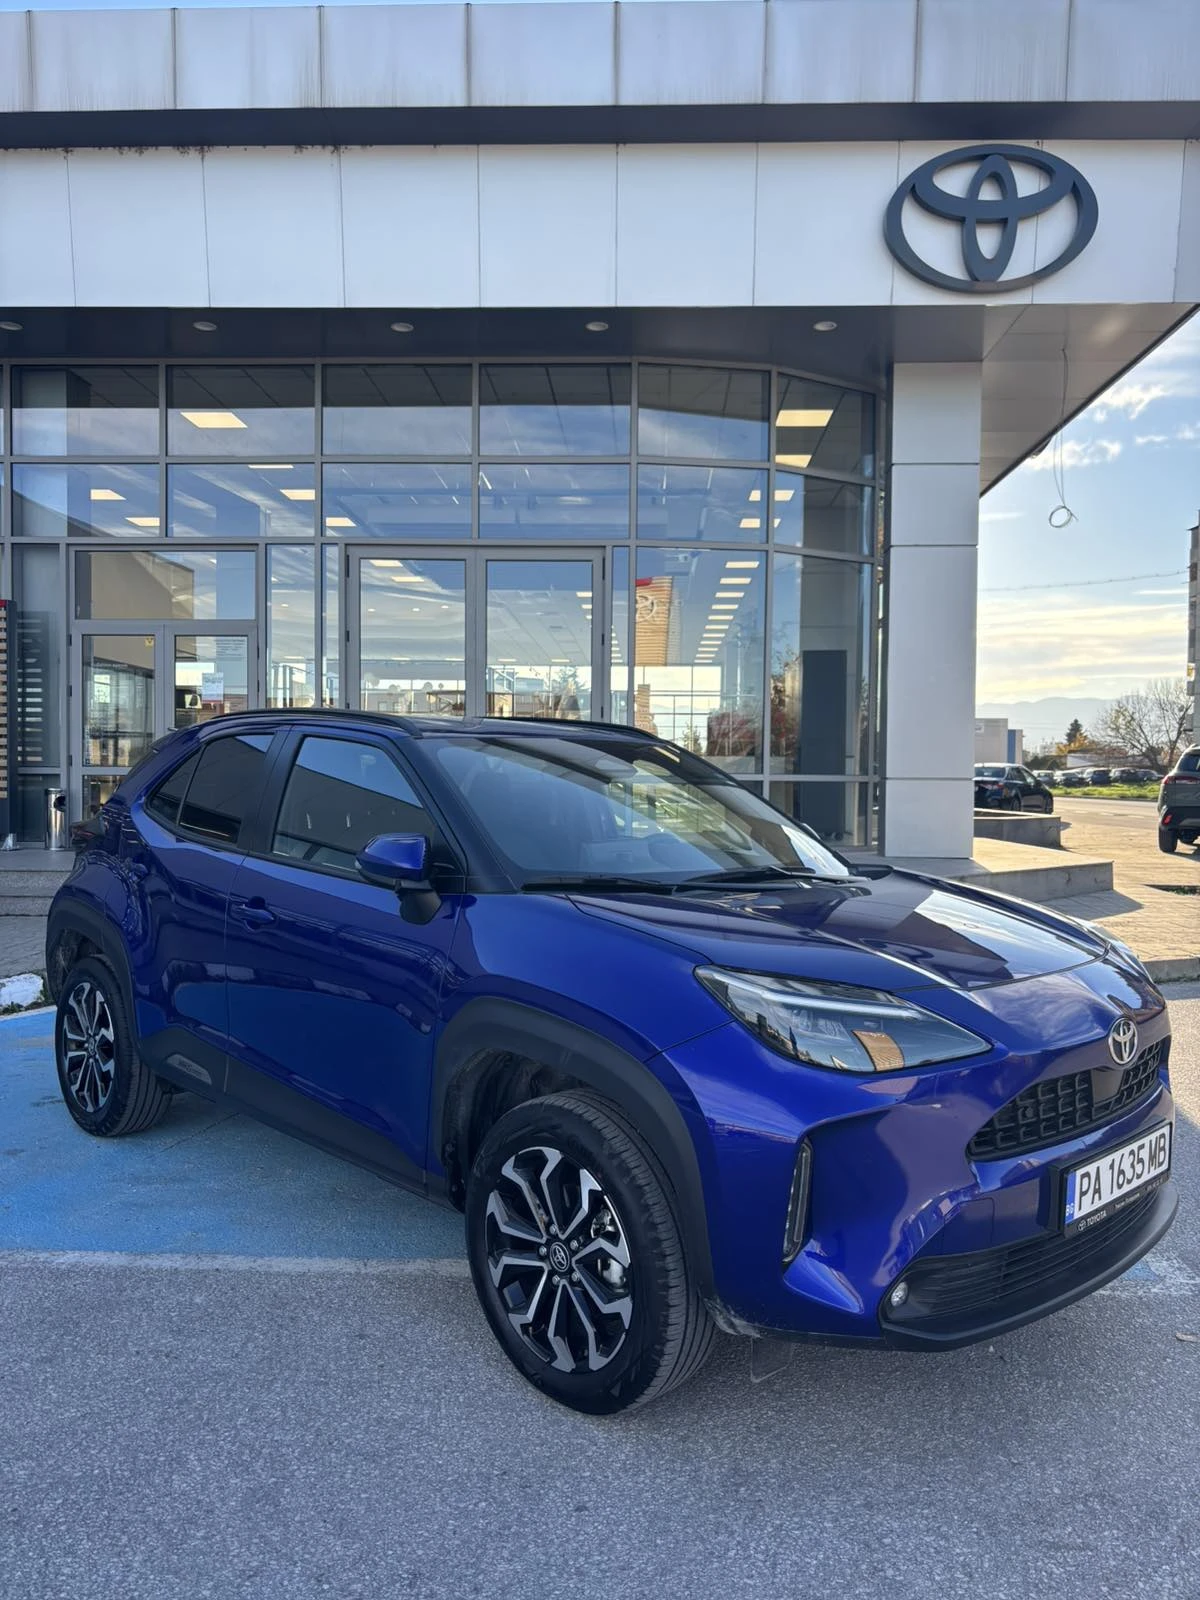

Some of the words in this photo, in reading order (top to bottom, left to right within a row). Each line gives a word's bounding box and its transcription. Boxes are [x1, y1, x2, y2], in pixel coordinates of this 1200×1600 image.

[1079, 1166, 1102, 1211] PA
[1109, 1143, 1145, 1194] 1635
[1147, 1132, 1166, 1174] MB
[1087, 1210, 1107, 1226] TOYOTA
